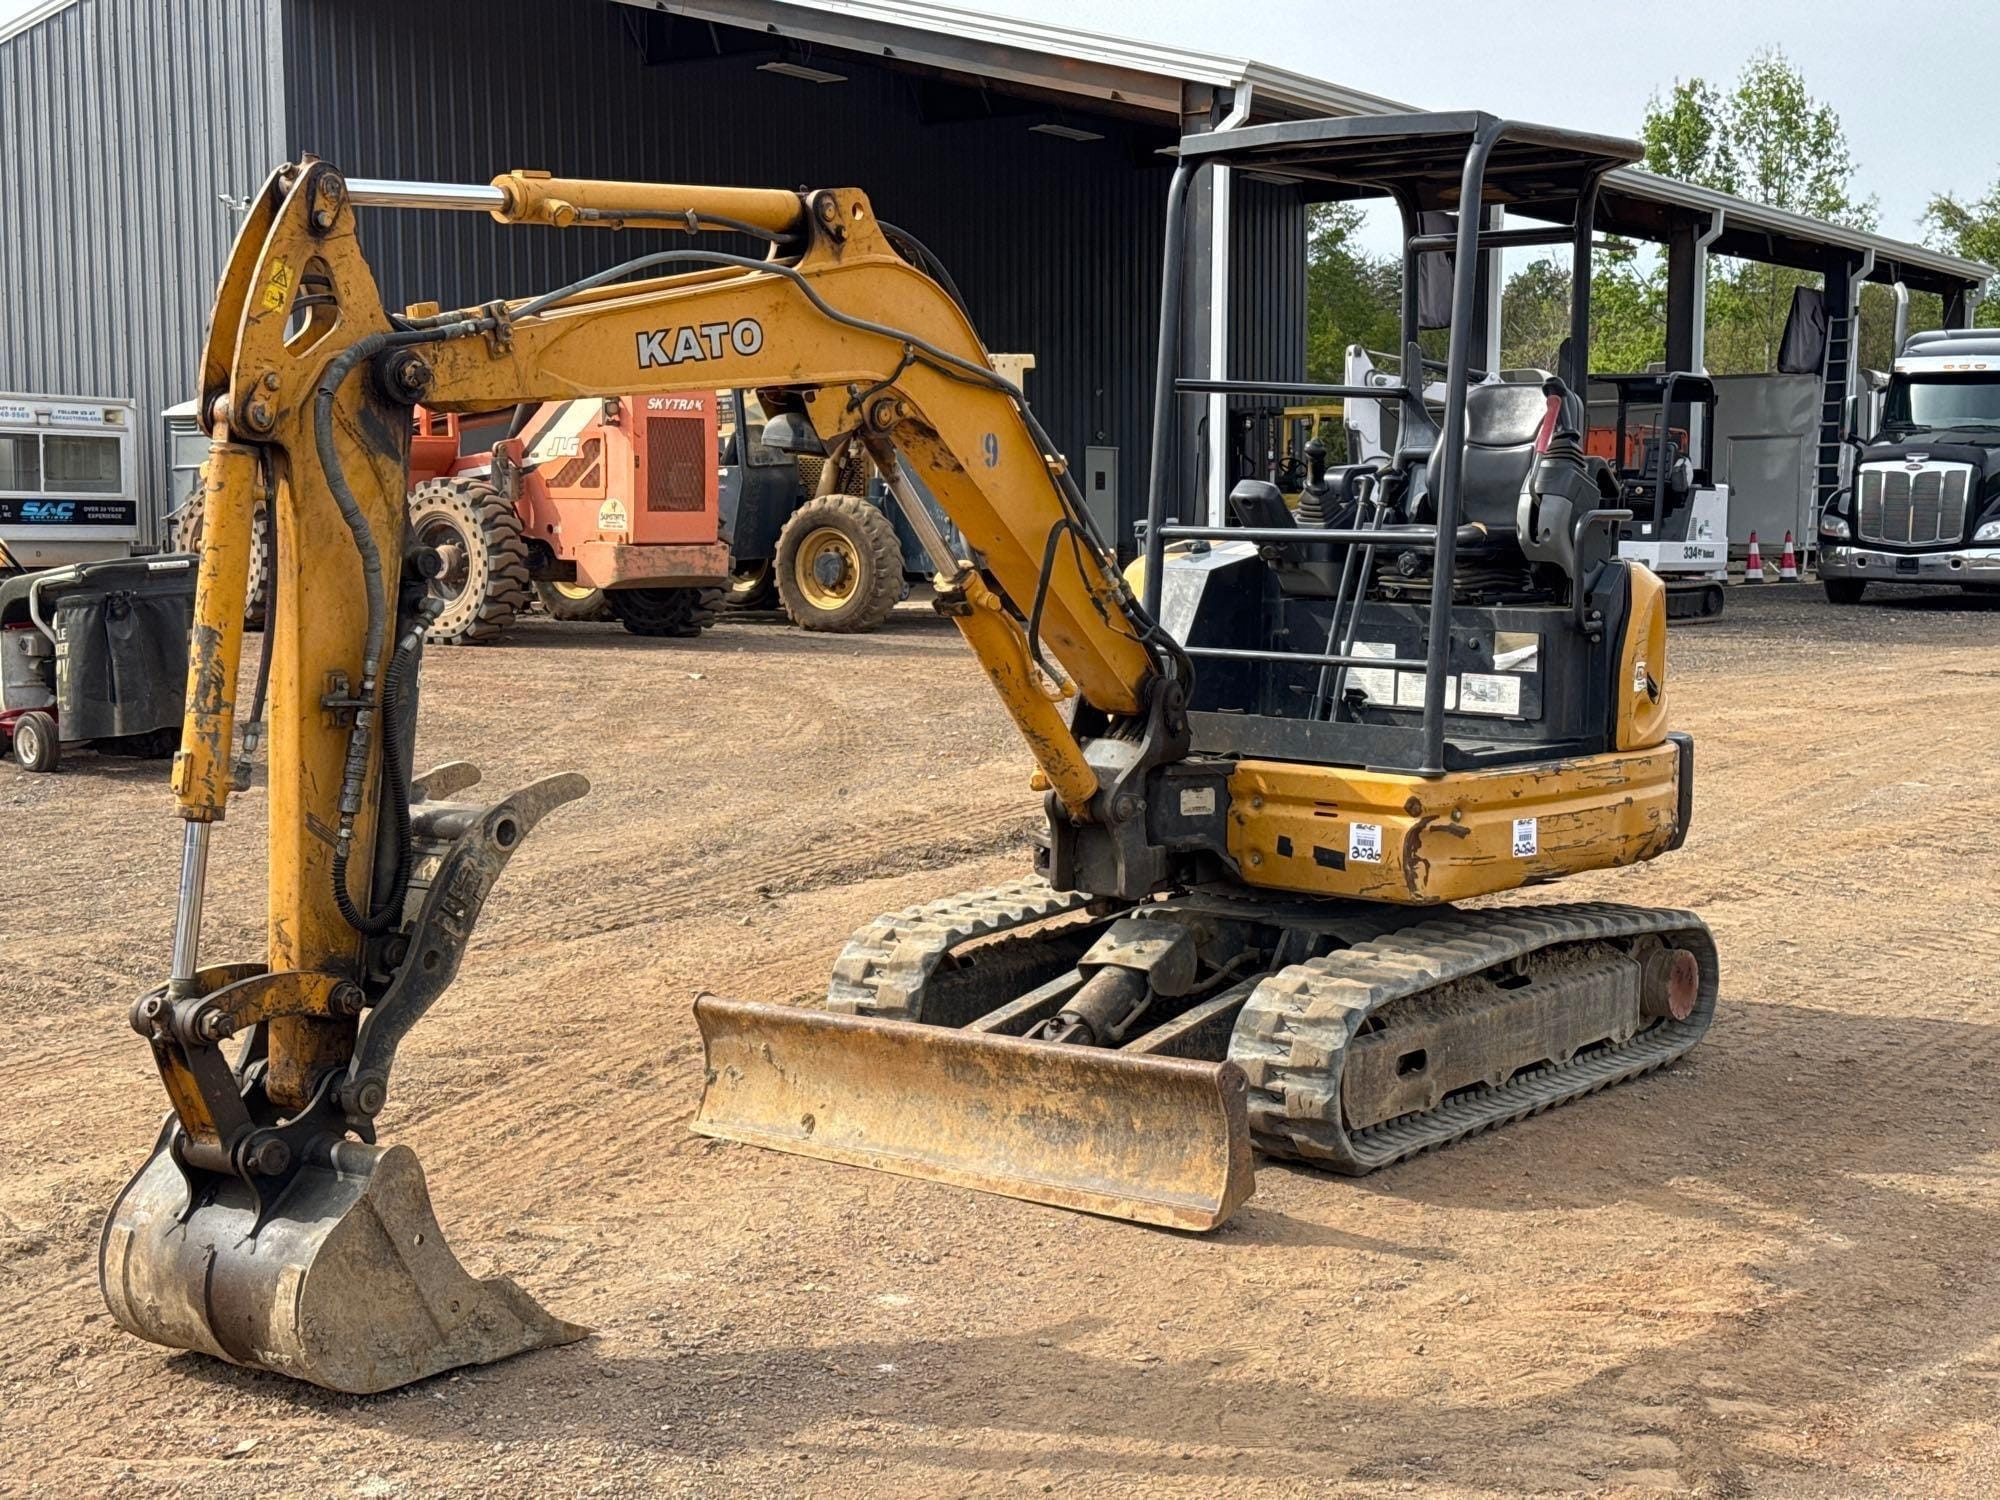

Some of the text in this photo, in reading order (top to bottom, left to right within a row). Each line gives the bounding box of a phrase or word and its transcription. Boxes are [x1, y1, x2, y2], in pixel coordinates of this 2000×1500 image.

[636, 317, 763, 369] KATO
[647, 397, 704, 411] SKYTRAK
[547, 437, 580, 456] JLG
[984, 432, 998, 468] 9
[20, 502, 76, 516] SAC
[1683, 546, 1698, 559] 334
[1351, 845, 1382, 861] 2026
[1514, 842, 1536, 855] 2026
